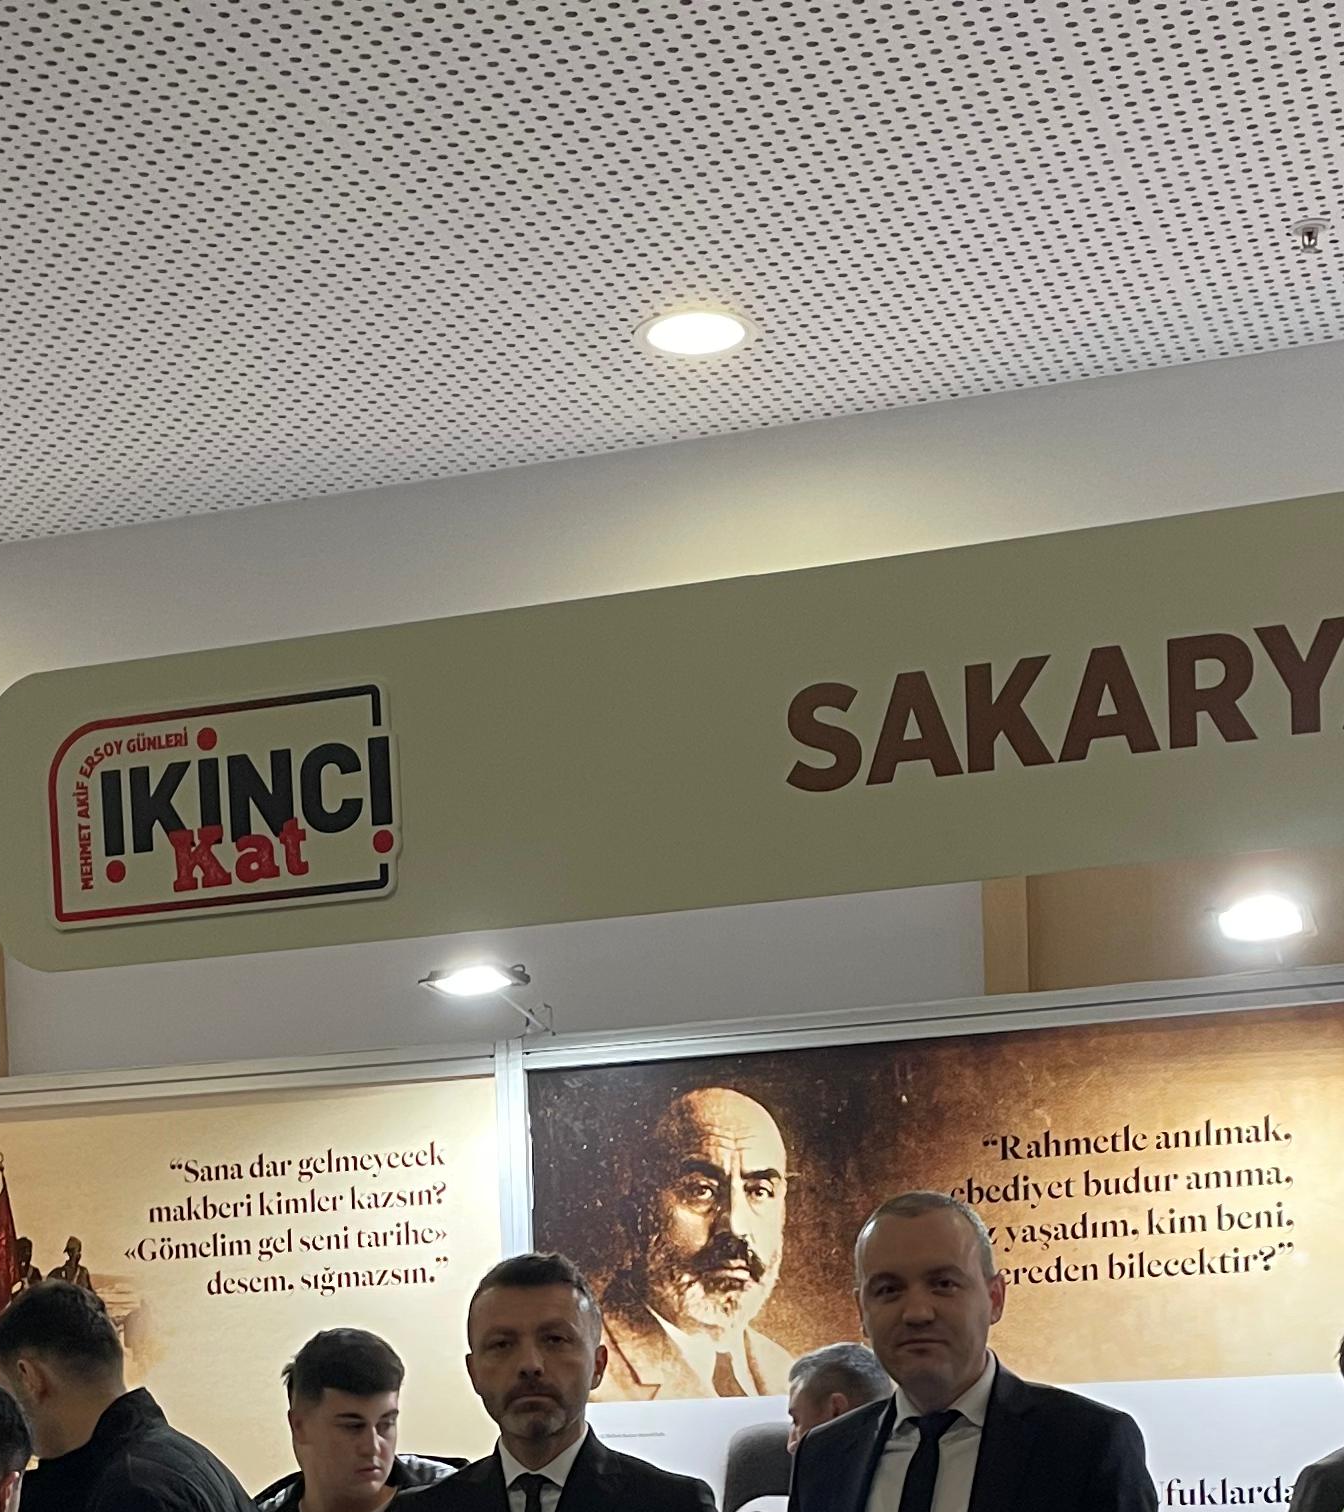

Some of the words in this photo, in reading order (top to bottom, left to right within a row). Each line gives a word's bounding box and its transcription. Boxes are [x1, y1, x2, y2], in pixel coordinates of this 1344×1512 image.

[127, 727, 188, 753] GÜNLERİ
[79, 740, 123, 779] ERSOY
[78, 824, 94, 890] MEHMET
[169, 817, 310, 892] Kat
[1155, 1114, 1293, 1149] anılmak,
[249, 1154, 293, 1179] dar
[297, 1141, 446, 1183] gelmeyecek
[1084, 1166, 1178, 1197] budur
[1186, 1165, 1294, 1191] amma,
[149, 1193, 252, 1224] makberi
[259, 1188, 344, 1218] kimler
[351, 1180, 447, 1211] kazsın?
[258, 1230, 293, 1262] gel
[299, 1227, 349, 1252] seni
[1004, 1213, 1140, 1251] yaşadım,
[1147, 1207, 1207, 1236] kim
[1216, 1201, 1295, 1233] beni,
[207, 1272, 294, 1297] desem,
[999, 1252, 1099, 1286] ereden
